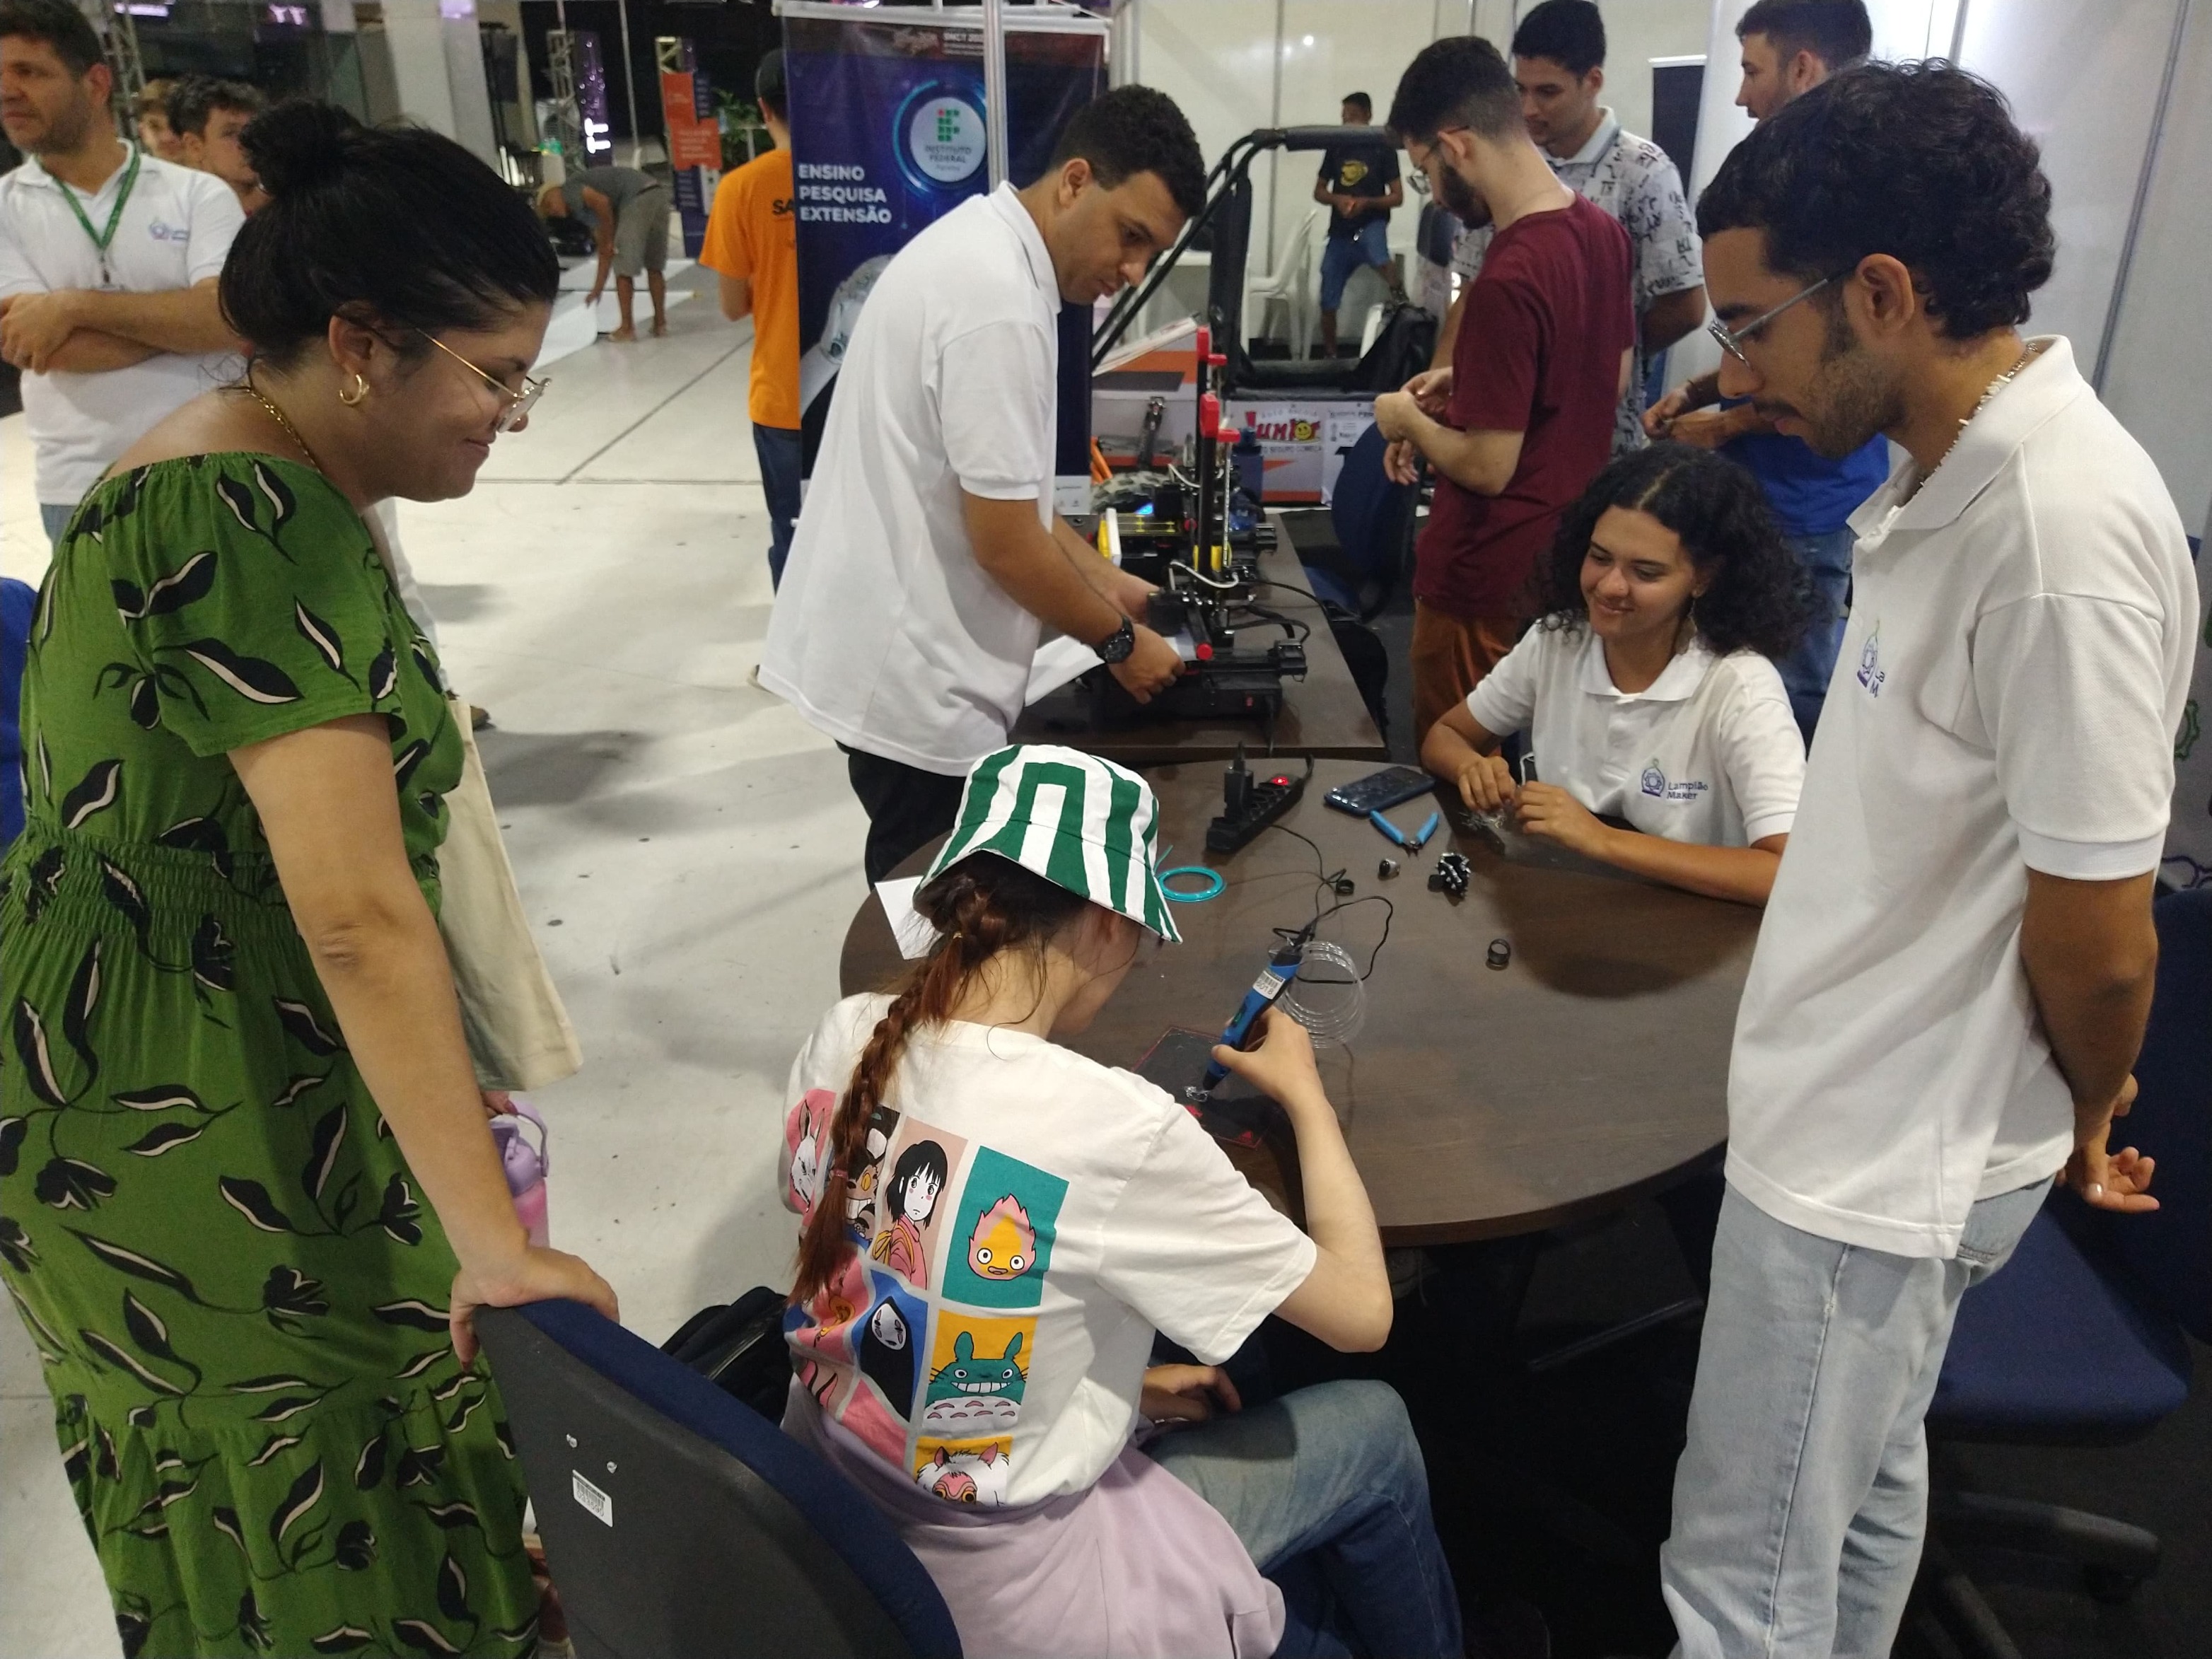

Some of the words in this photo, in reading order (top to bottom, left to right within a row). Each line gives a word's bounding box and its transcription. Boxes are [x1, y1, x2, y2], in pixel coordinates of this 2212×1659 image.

[798, 163, 865, 181] ENSINO
[798, 185, 887, 204] PESQUISA
[800, 205, 892, 223] EXTENSÃO
[1667, 791, 1698, 799] Maker
[1668, 781, 1709, 791] Lampião
